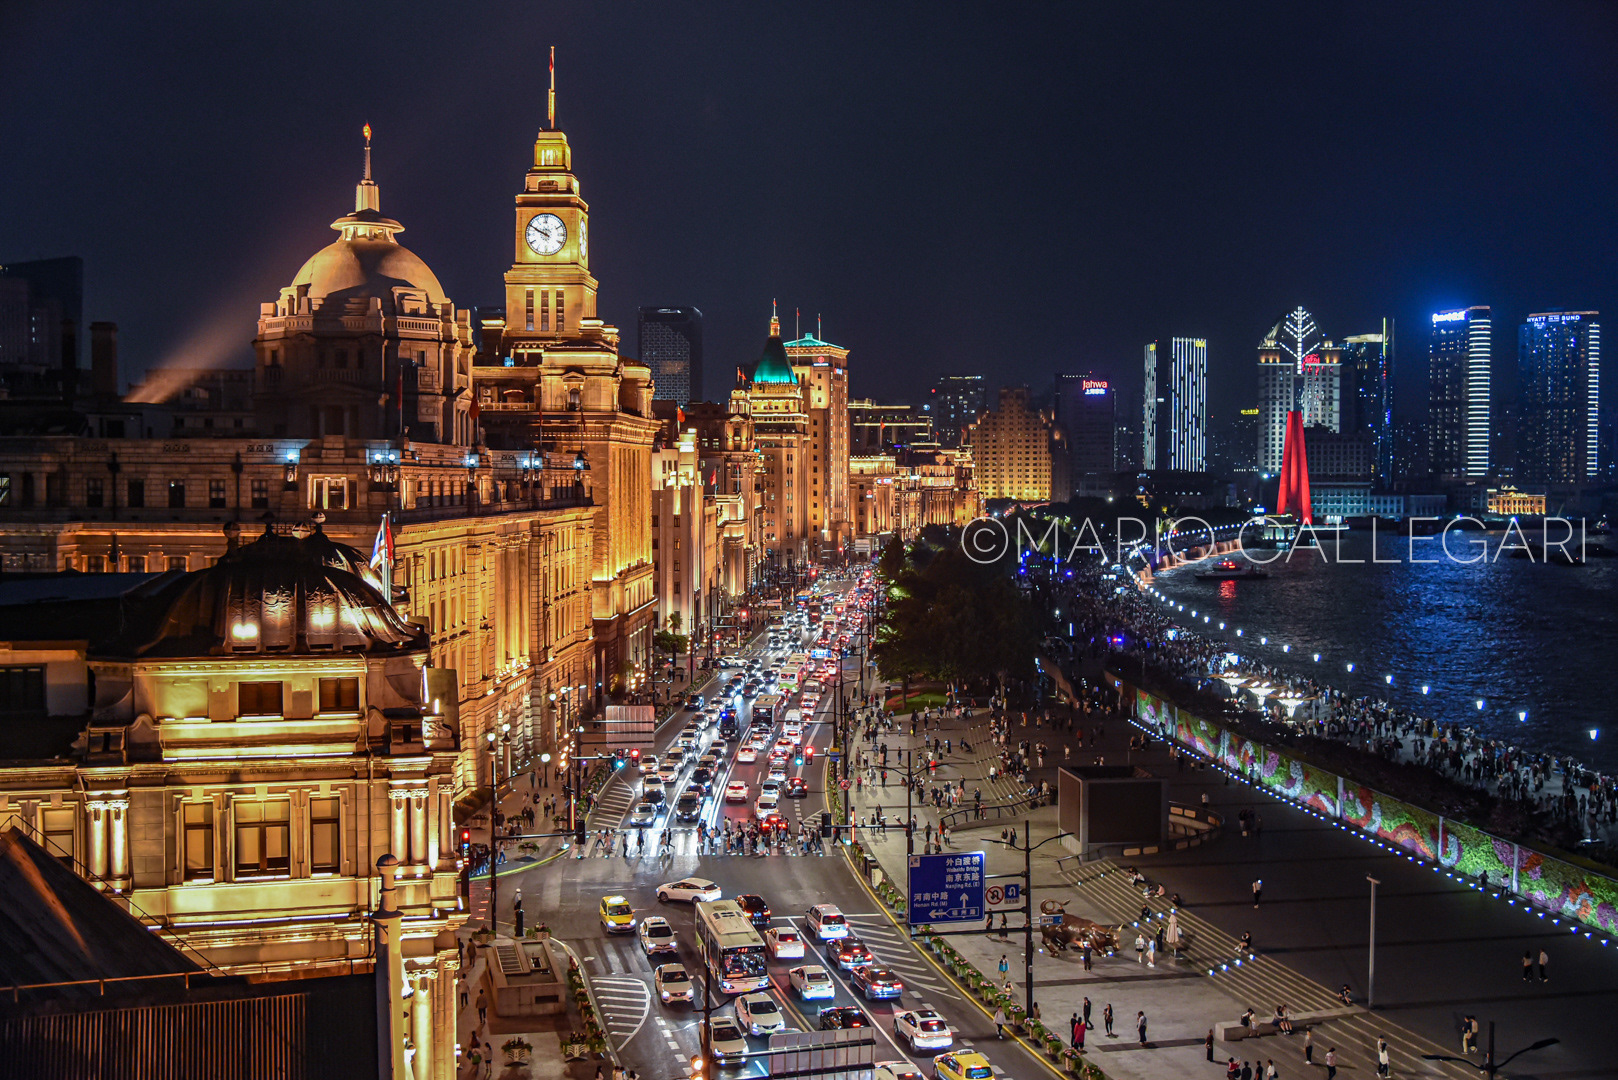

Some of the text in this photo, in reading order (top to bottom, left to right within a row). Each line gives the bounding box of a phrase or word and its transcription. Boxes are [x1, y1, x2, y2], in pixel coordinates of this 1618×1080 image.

[1082, 380, 1108, 391] Jahwa
[945, 856, 980, 867] 外白渡桥
[945, 872, 980, 883] 南京东路
[913, 891, 949, 902] 河南中路
